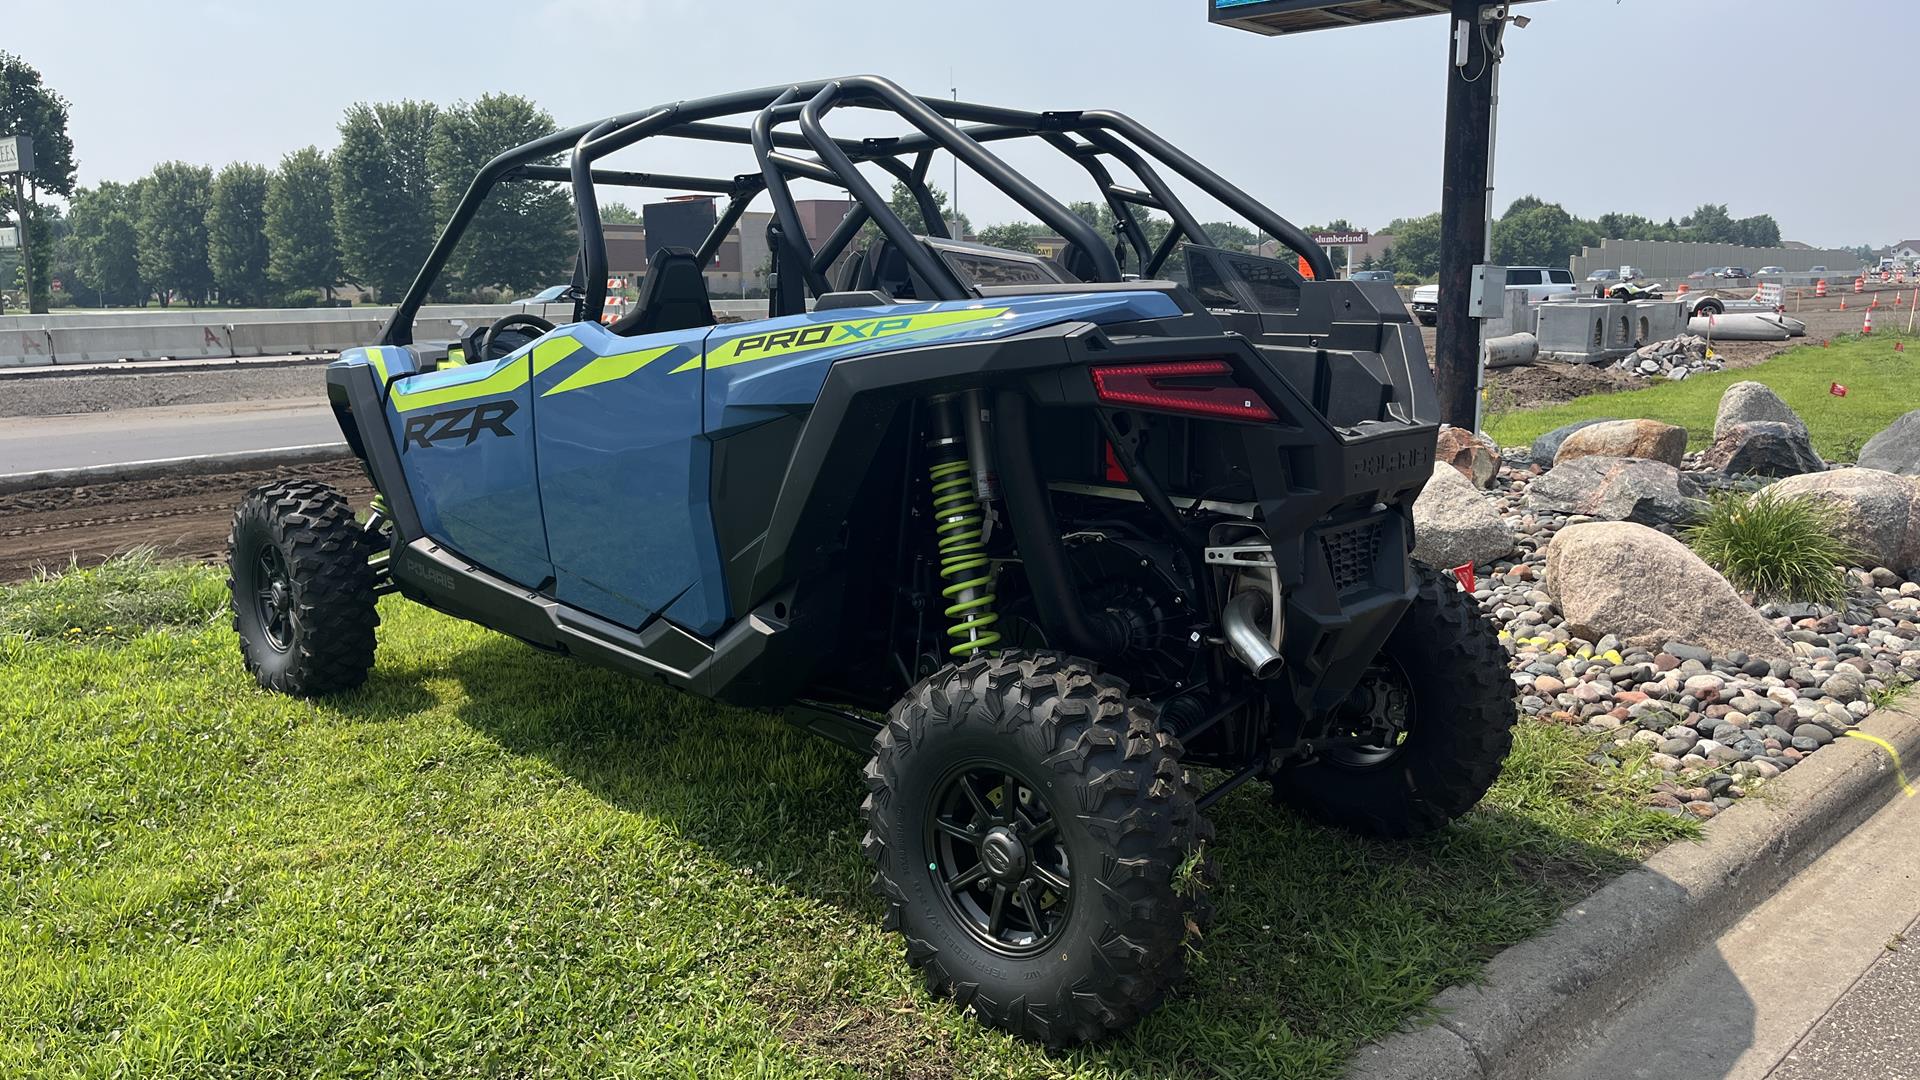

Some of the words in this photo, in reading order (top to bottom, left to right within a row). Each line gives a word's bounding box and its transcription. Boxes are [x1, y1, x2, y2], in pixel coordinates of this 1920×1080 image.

[1315, 234, 1363, 243] slumberland
[733, 325, 834, 357] PRO
[832, 318, 912, 342] XP
[403, 400, 519, 455] RZR
